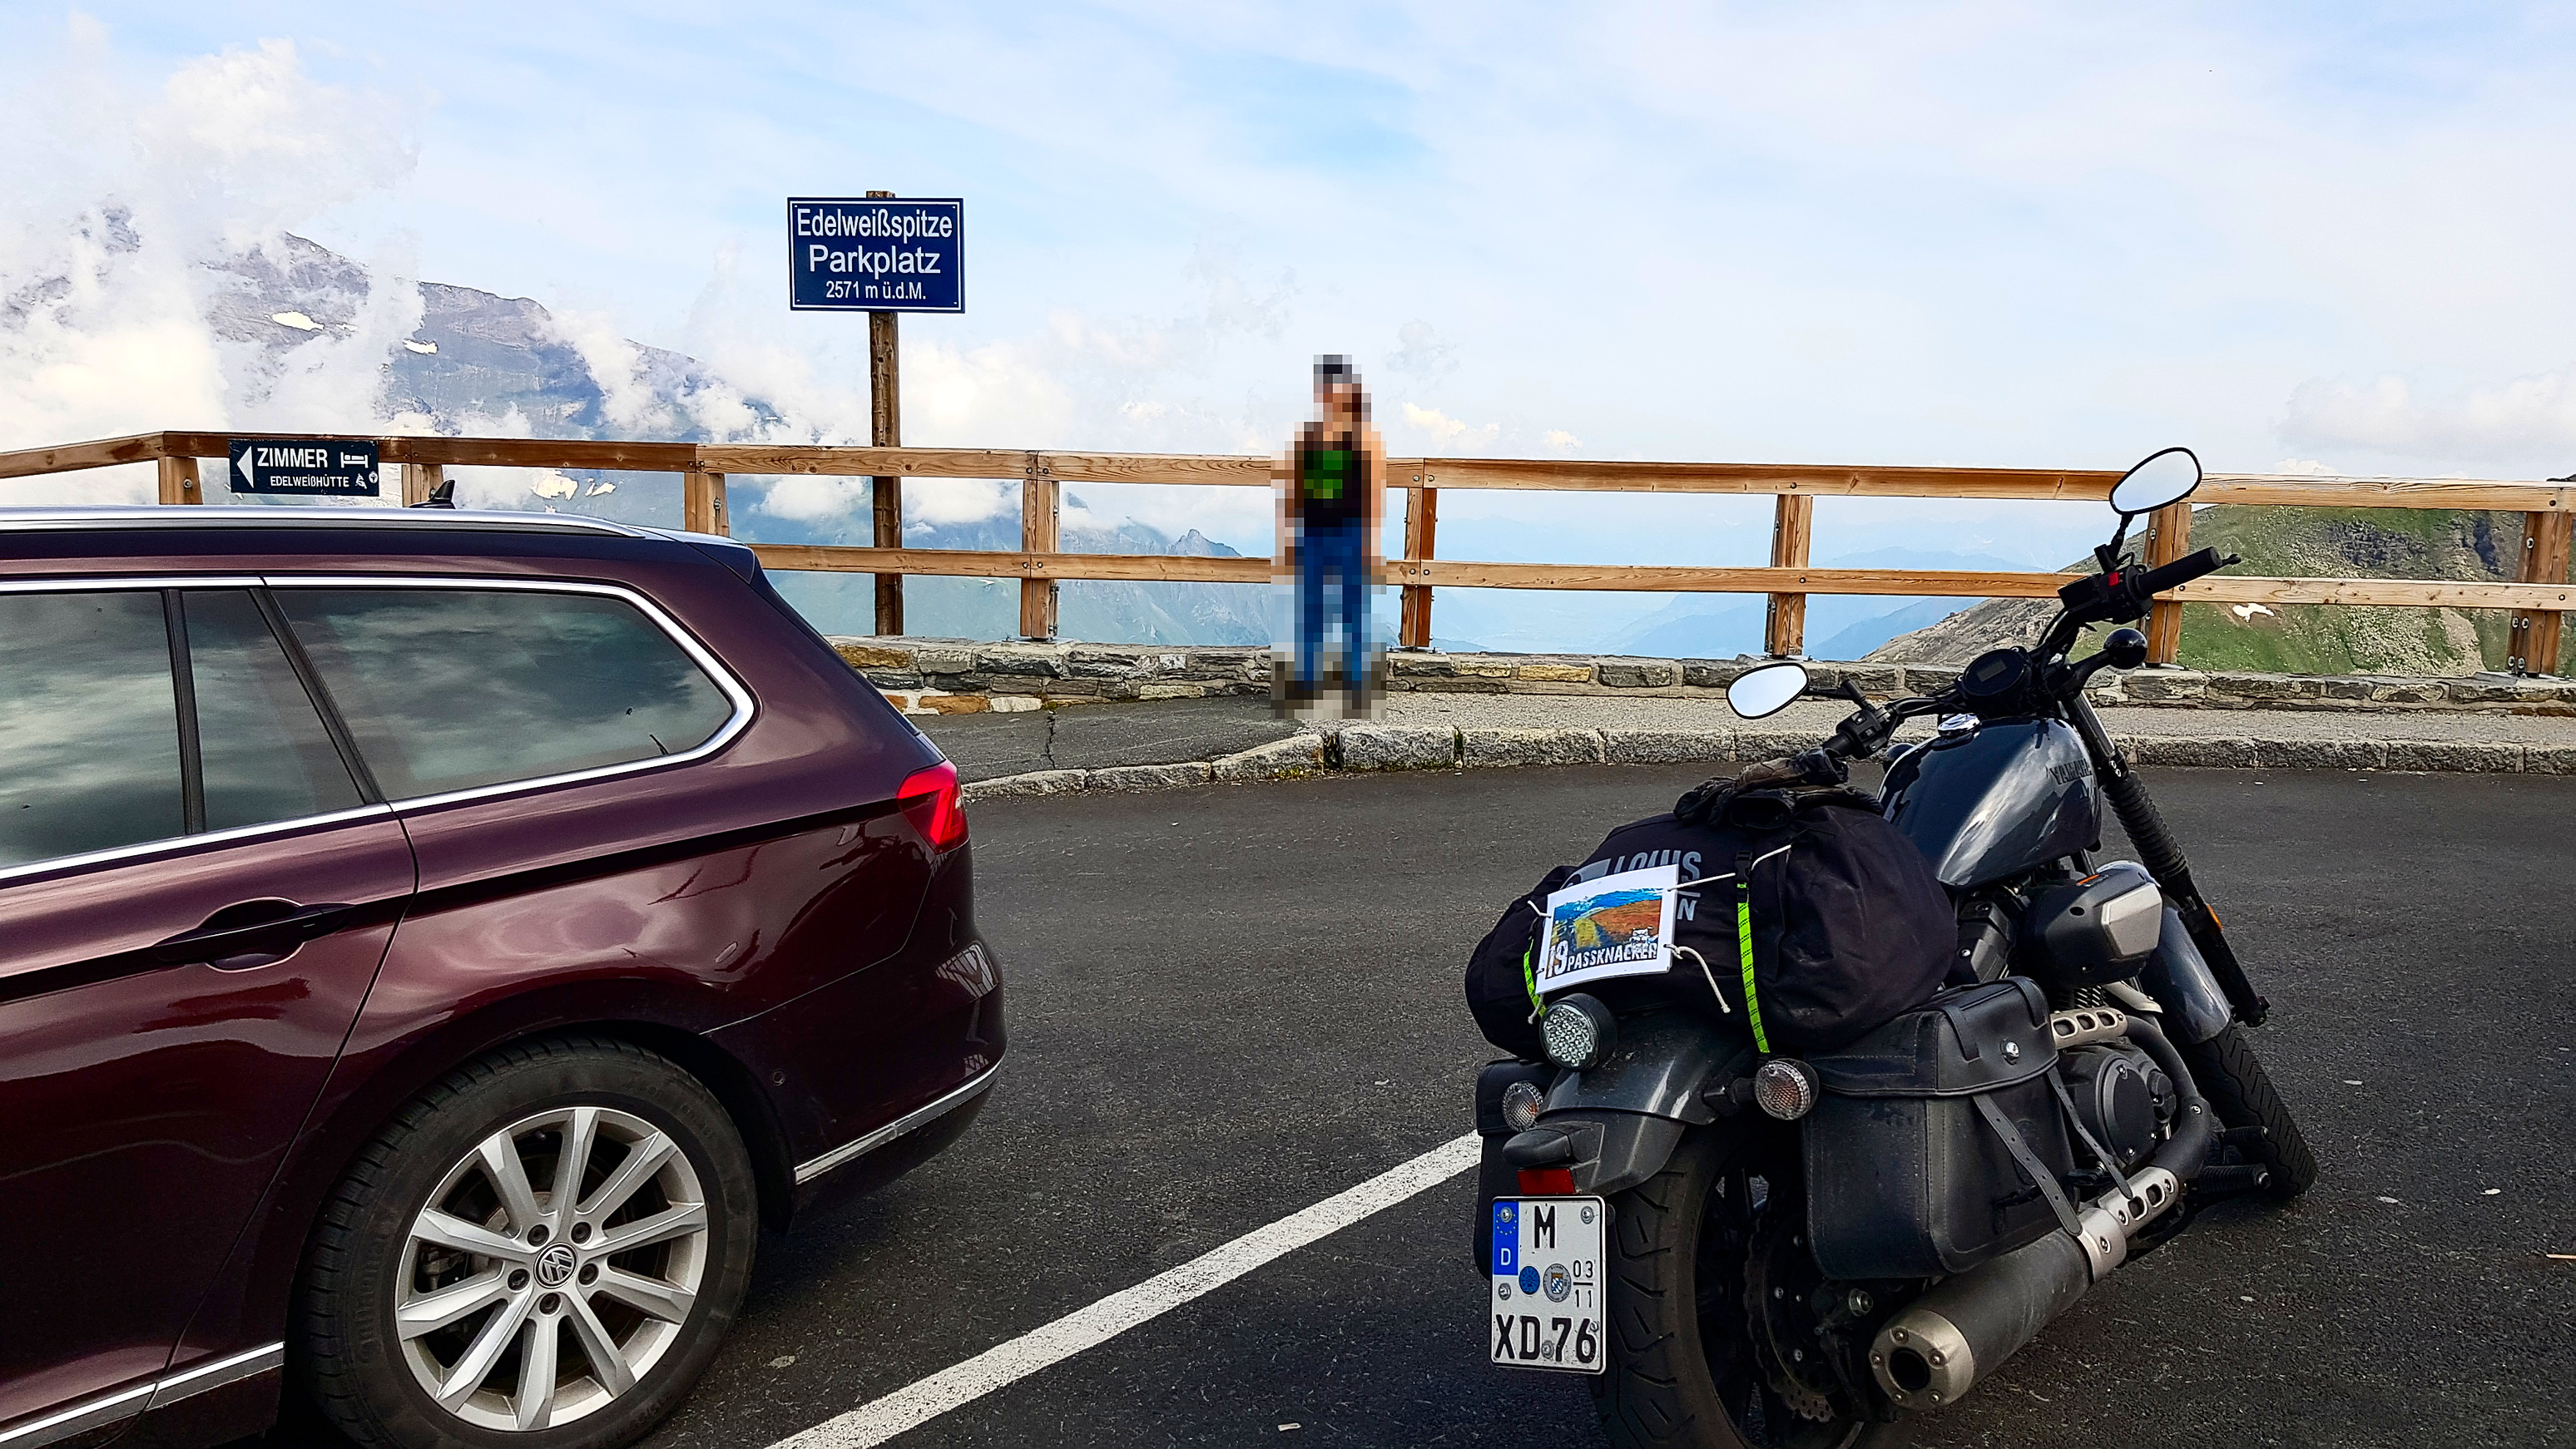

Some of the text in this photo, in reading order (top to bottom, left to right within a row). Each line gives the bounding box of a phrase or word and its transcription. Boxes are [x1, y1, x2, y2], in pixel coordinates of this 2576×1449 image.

[797, 208, 953, 244] Edelweißspitze
[809, 244, 941, 279] Parkplatz
[825, 280, 926, 299] 2571 m ü.d.M.
[257, 448, 328, 468] ZIMMER
[2048, 758, 2093, 785] YAMAHA
[1567, 942, 1657, 972] PASSKNACKER
[1534, 1205, 1555, 1249] M
[1500, 1248, 1511, 1266] D
[1573, 1259, 1593, 1278] 03
[1575, 1289, 1593, 1308] 11
[1494, 1313, 1597, 1364] XD 76
